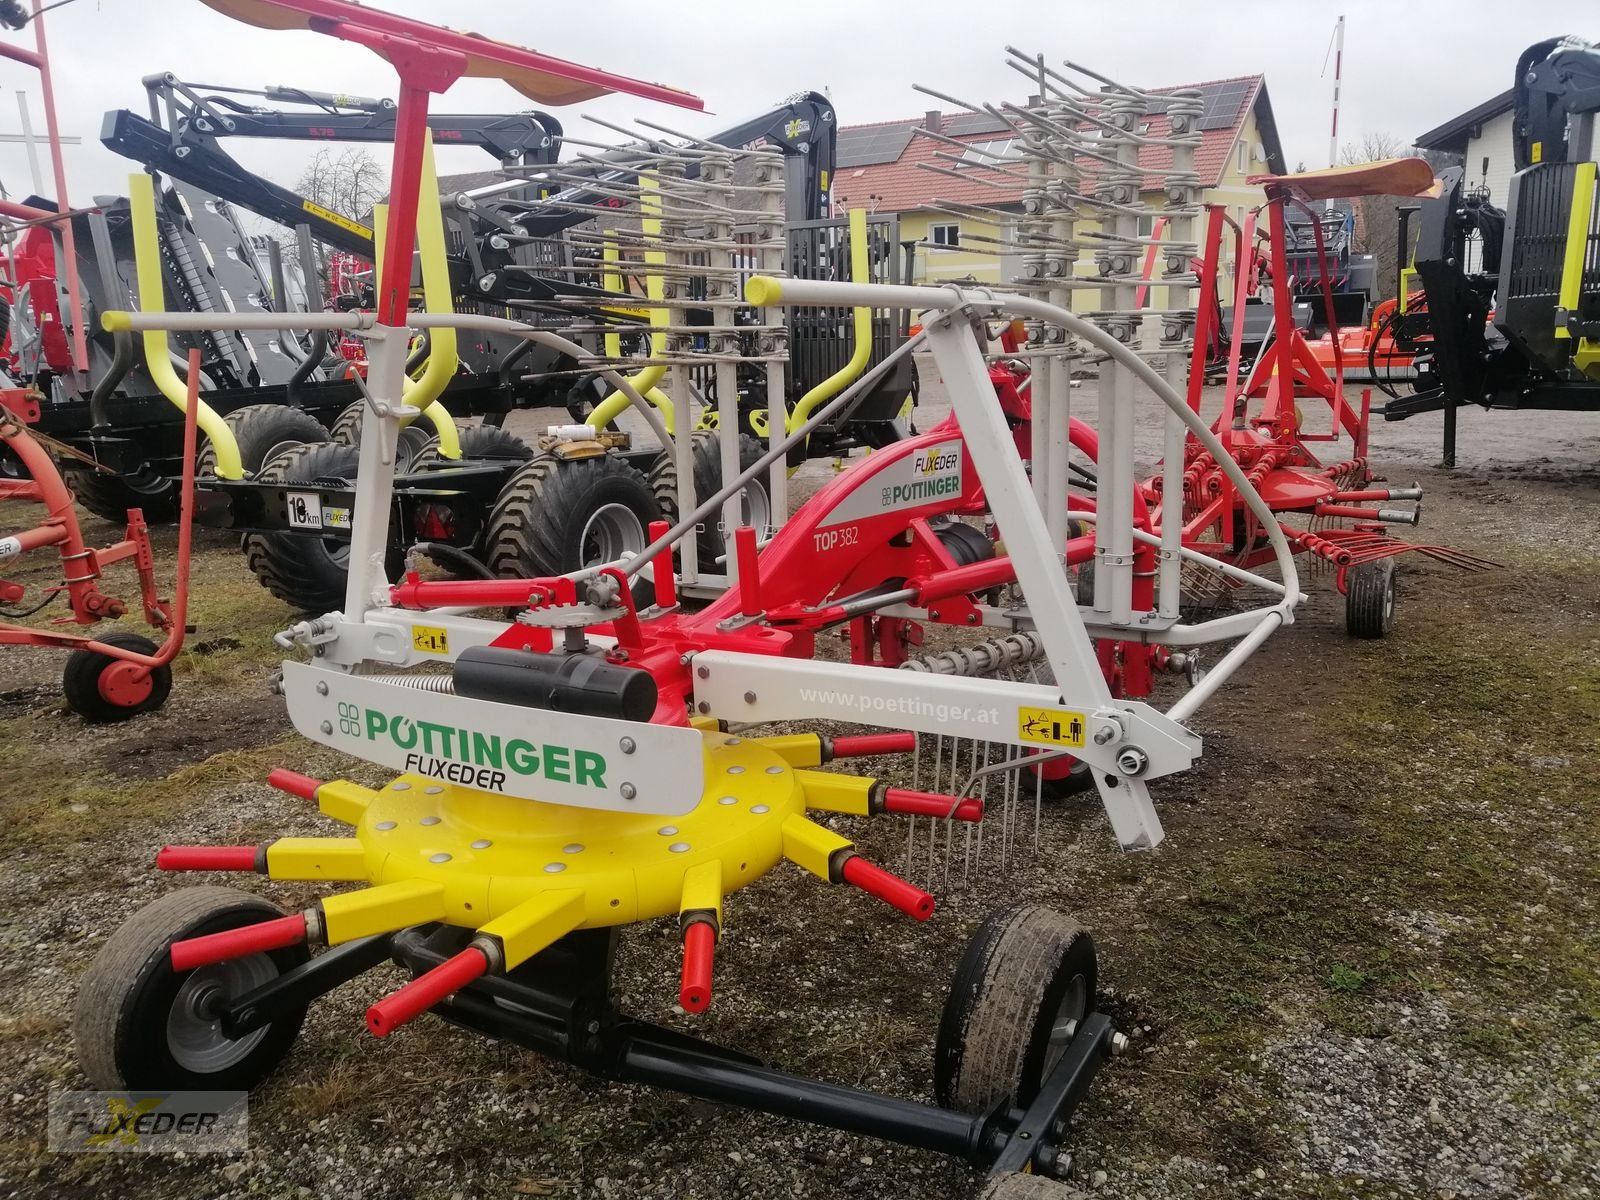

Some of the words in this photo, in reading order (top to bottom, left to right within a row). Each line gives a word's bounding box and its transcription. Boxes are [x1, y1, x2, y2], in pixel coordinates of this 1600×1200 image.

[915, 454, 958, 473] FLIXEDER
[325, 512, 349, 522] FLIXED
[814, 532, 838, 552] TOP
[839, 526, 858, 547] 382
[799, 687, 1000, 725] www.poettinger.at
[404, 753, 507, 792] FLIXEDER
